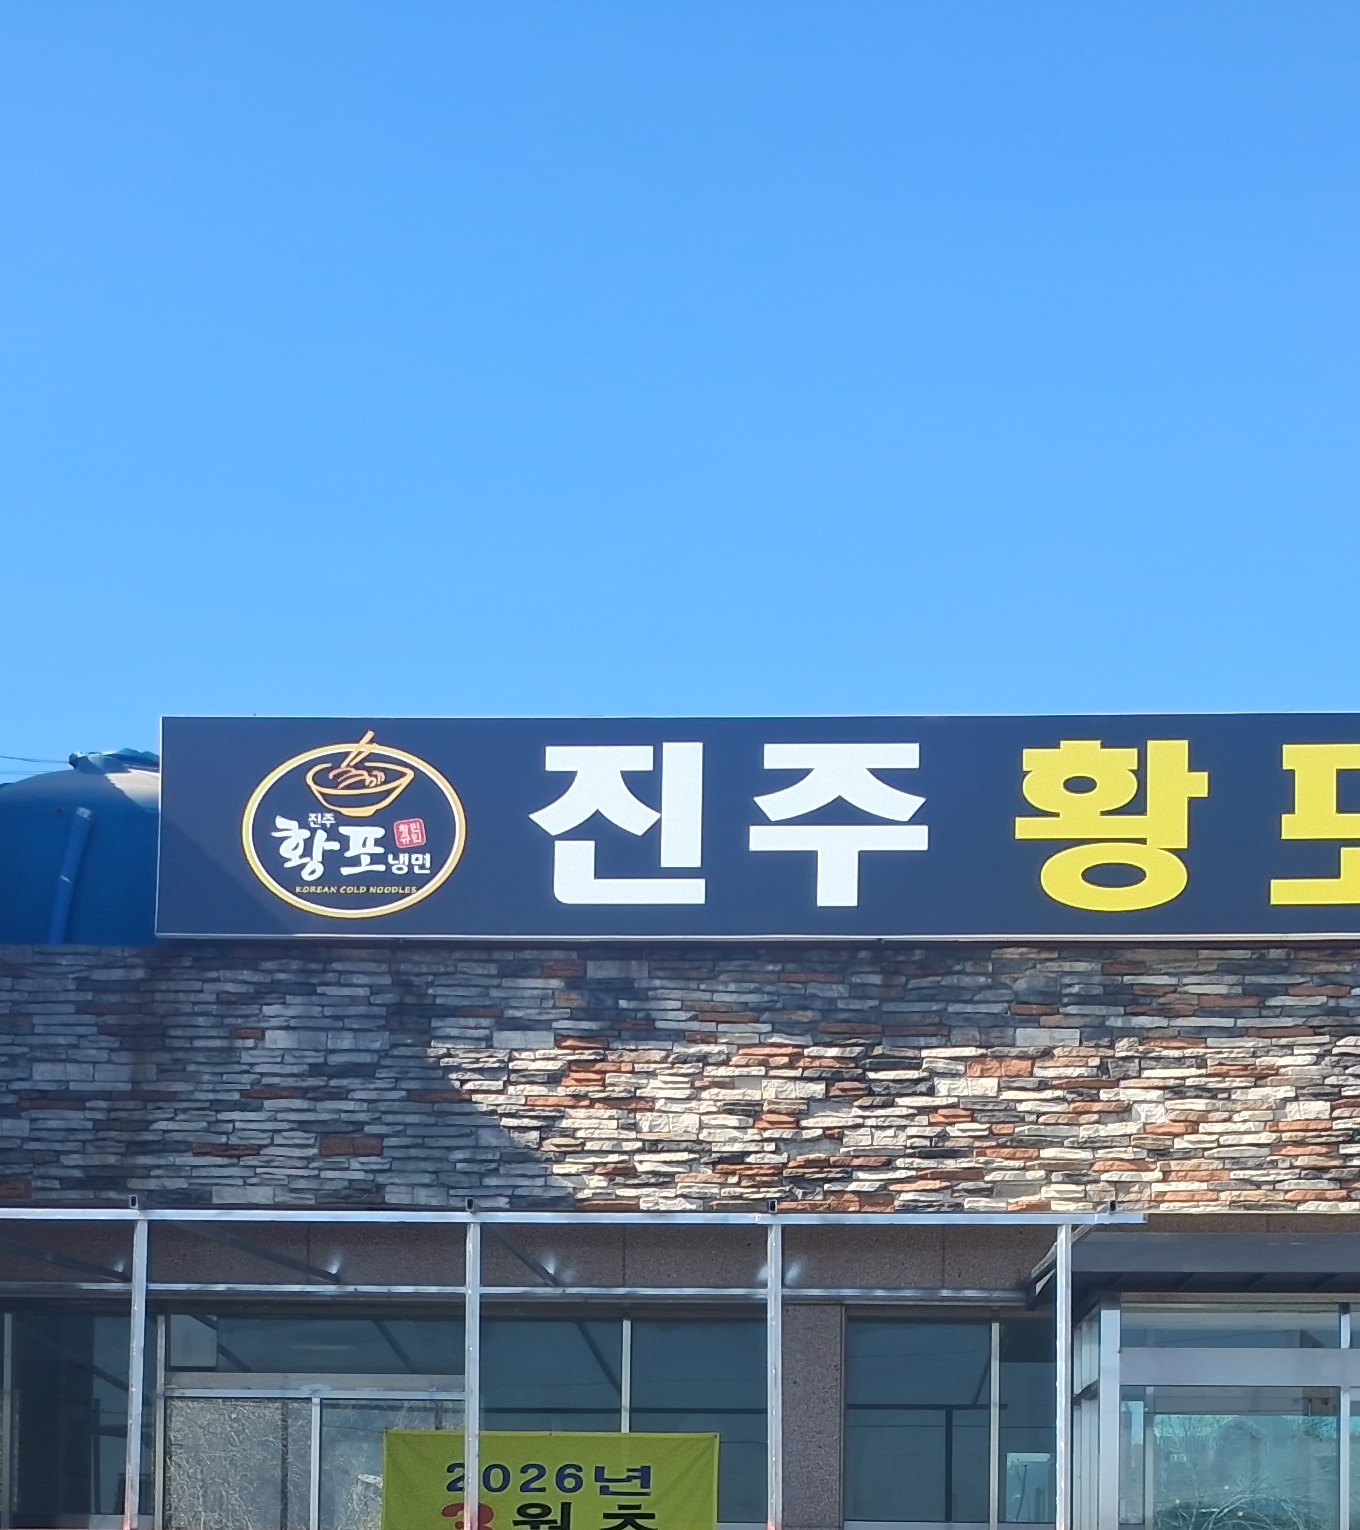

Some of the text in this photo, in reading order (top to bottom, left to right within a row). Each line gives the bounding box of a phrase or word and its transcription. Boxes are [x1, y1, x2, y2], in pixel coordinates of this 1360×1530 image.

[307, 812, 337, 829] 진주
[529, 741, 929, 909] 진주
[270, 814, 432, 882] 황포 냉면
[295, 885, 418, 894] KOREAN COLD NOODLES
[445, 1462, 652, 1497] 2026년
